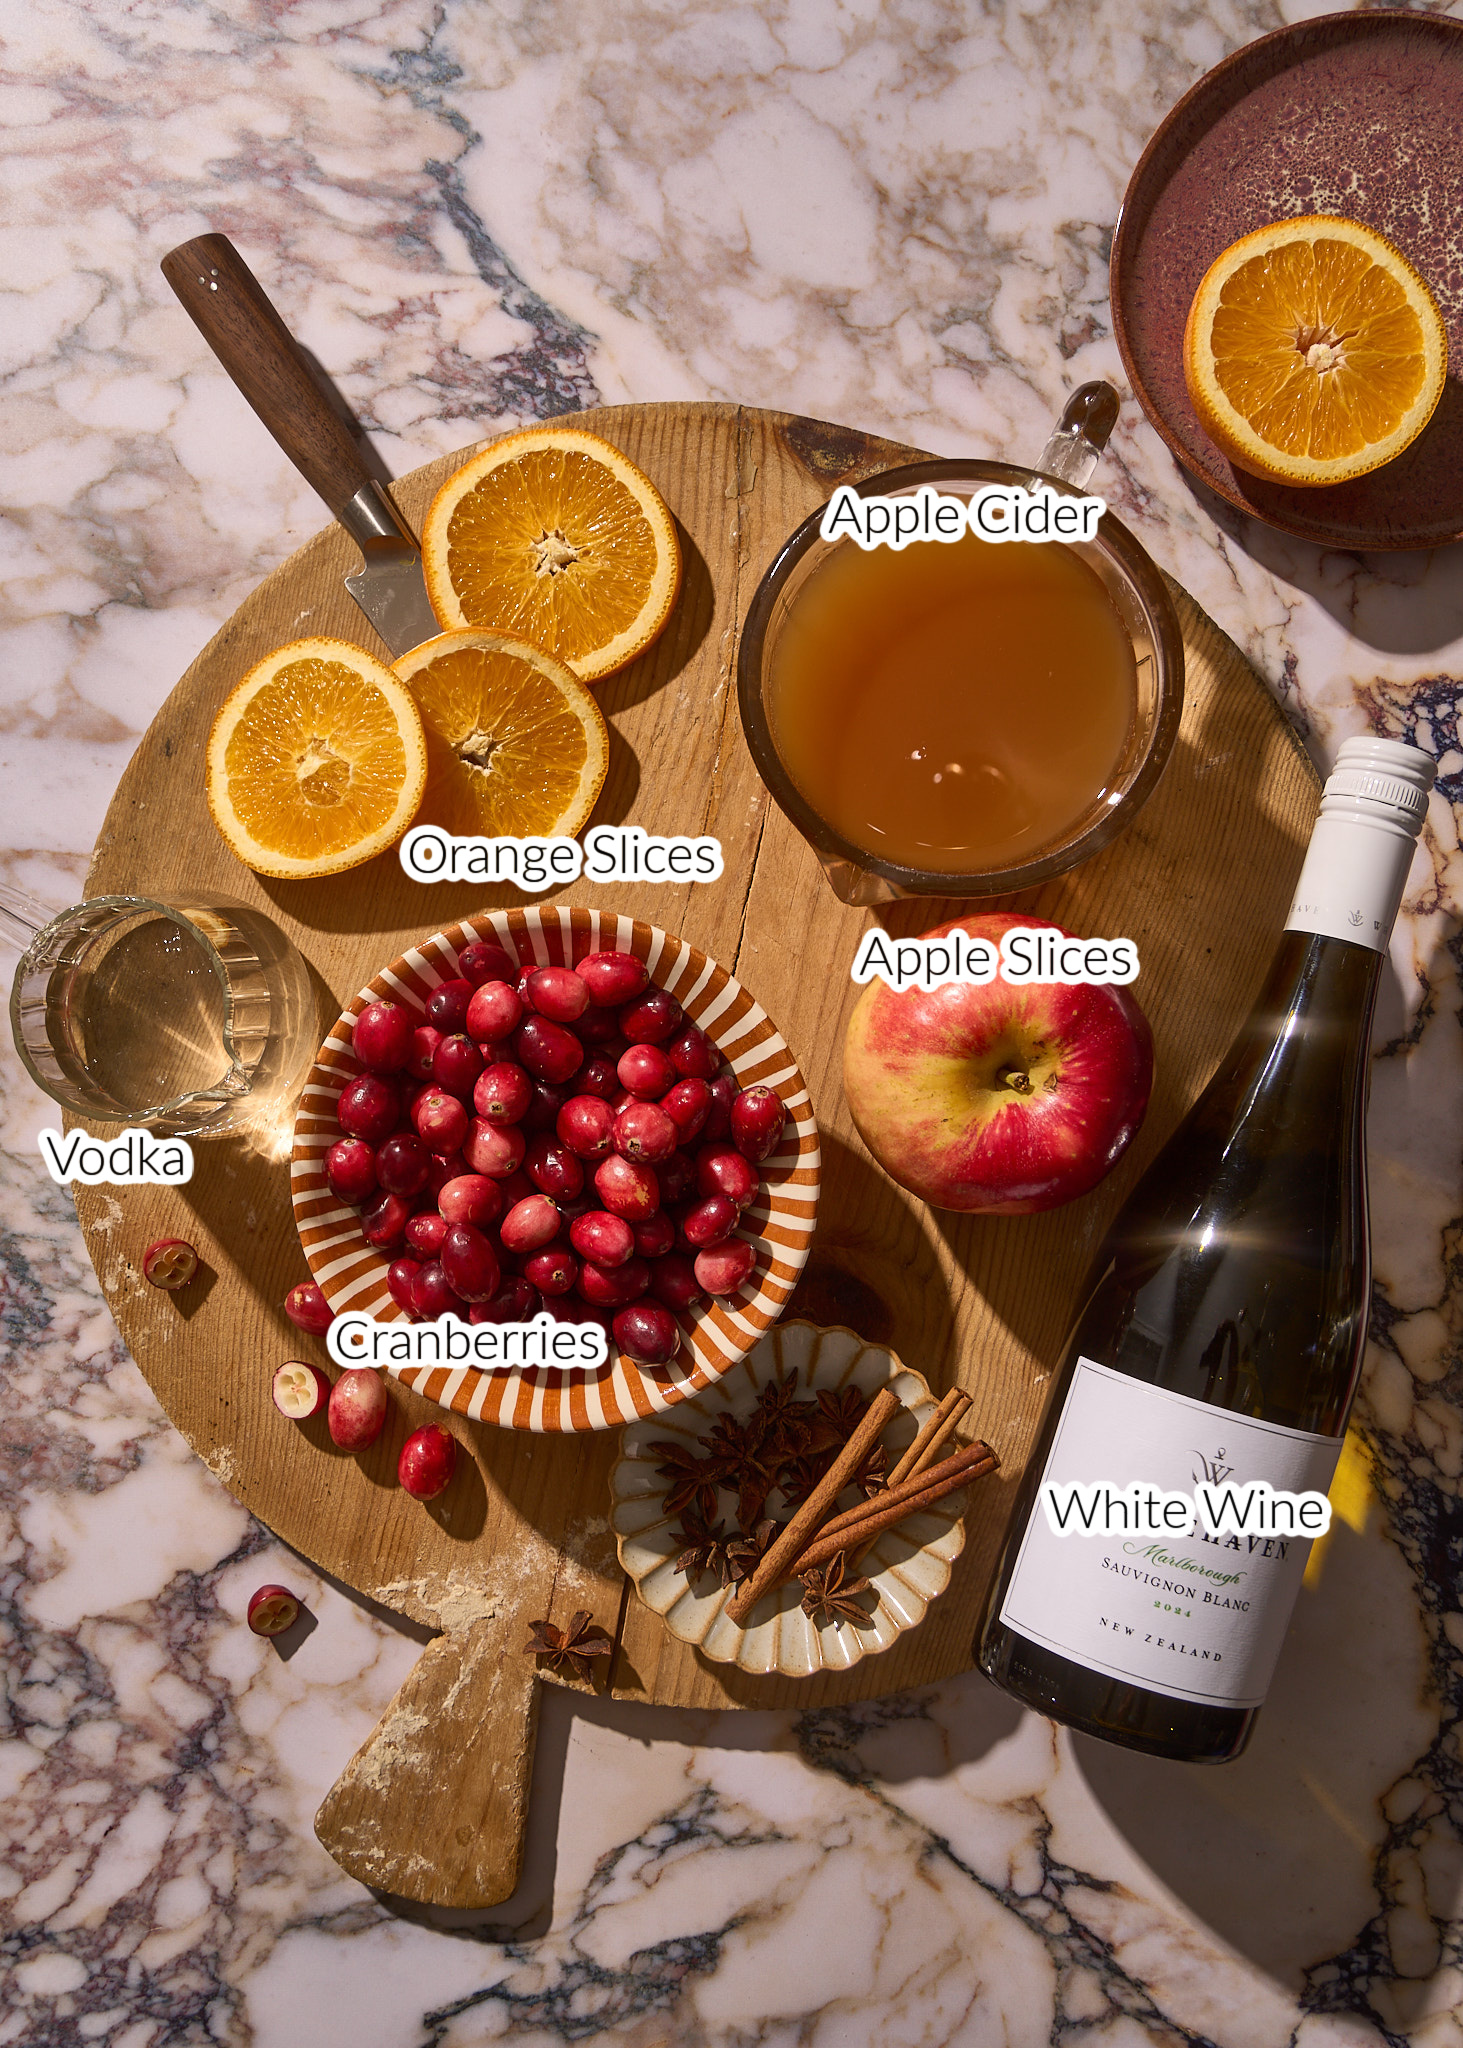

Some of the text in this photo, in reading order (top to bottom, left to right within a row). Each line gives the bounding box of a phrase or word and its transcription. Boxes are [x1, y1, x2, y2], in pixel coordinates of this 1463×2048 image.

[1101, 1556, 1250, 1612] SAUVIGNON BLANC
[1122, 1541, 1248, 1587] Marlborough
[1153, 1600, 1192, 1618] 2024
[1099, 1616, 1223, 1662] NEW ZEALAND
